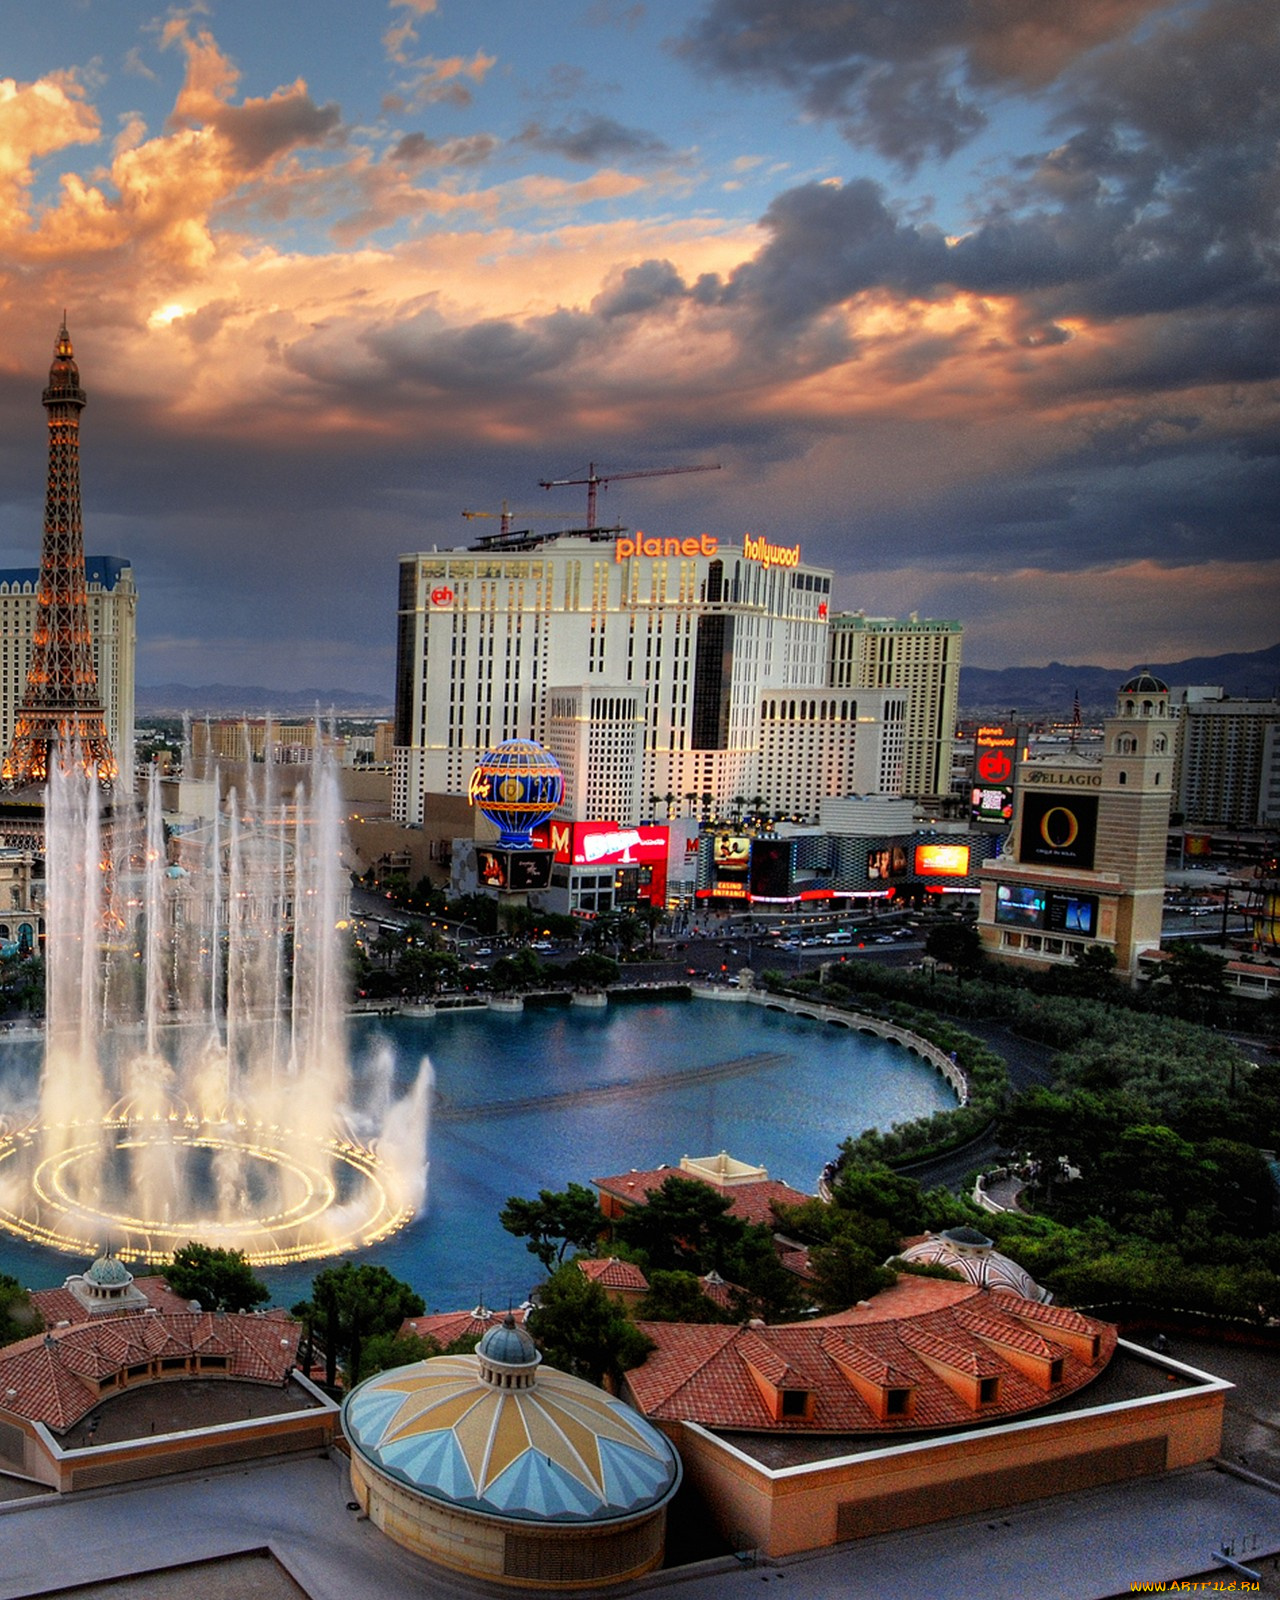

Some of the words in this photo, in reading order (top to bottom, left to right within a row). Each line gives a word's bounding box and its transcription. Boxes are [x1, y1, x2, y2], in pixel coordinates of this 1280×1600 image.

[615, 532, 718, 563] planet
[743, 534, 800, 569] hollywood
[552, 825, 569, 853] M
[1040, 807, 1079, 849] O
[713, 889, 745, 898] ENTRANCE
[717, 881, 742, 890] CASINO
